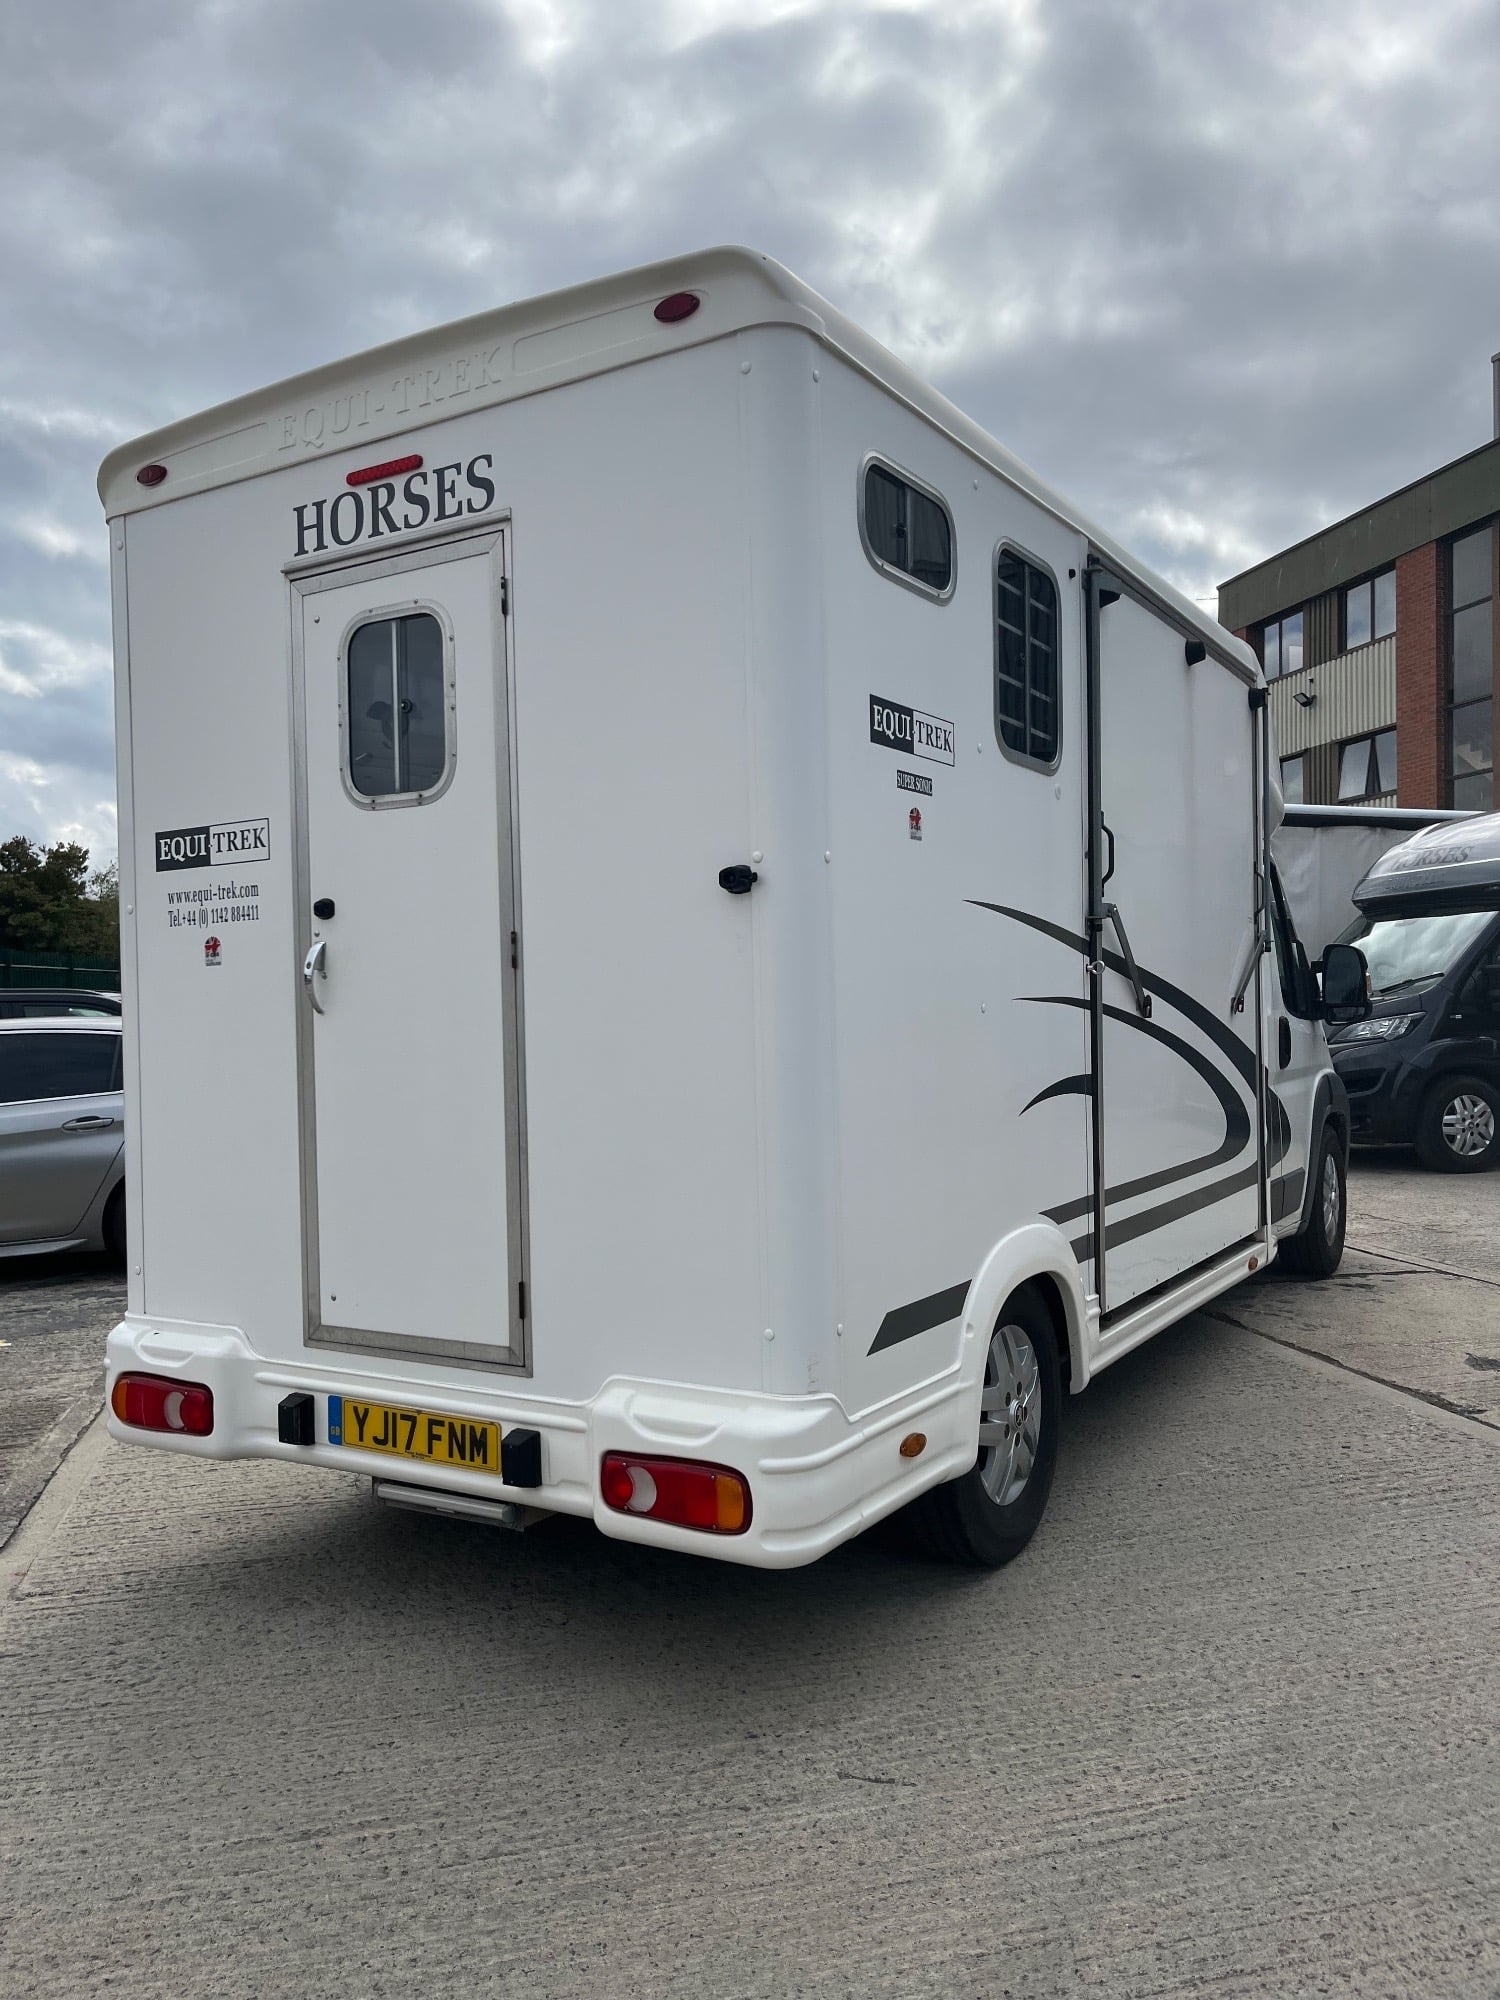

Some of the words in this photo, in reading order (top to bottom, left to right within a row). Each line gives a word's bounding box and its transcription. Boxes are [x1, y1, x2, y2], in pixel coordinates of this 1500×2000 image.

[278, 346, 502, 452] EQUI-TREK
[292, 454, 497, 557] HORSES
[897, 772, 915, 790] SUPER
[915, 777, 933, 795] SONIC
[167, 880, 260, 907] www.equi-trek.com
[198, 907, 209, 929] (0)
[211, 906, 229, 924] 1142
[230, 904, 260, 922] 884411
[352, 1405, 418, 1451] YJ17
[427, 1418, 489, 1466] FNM
